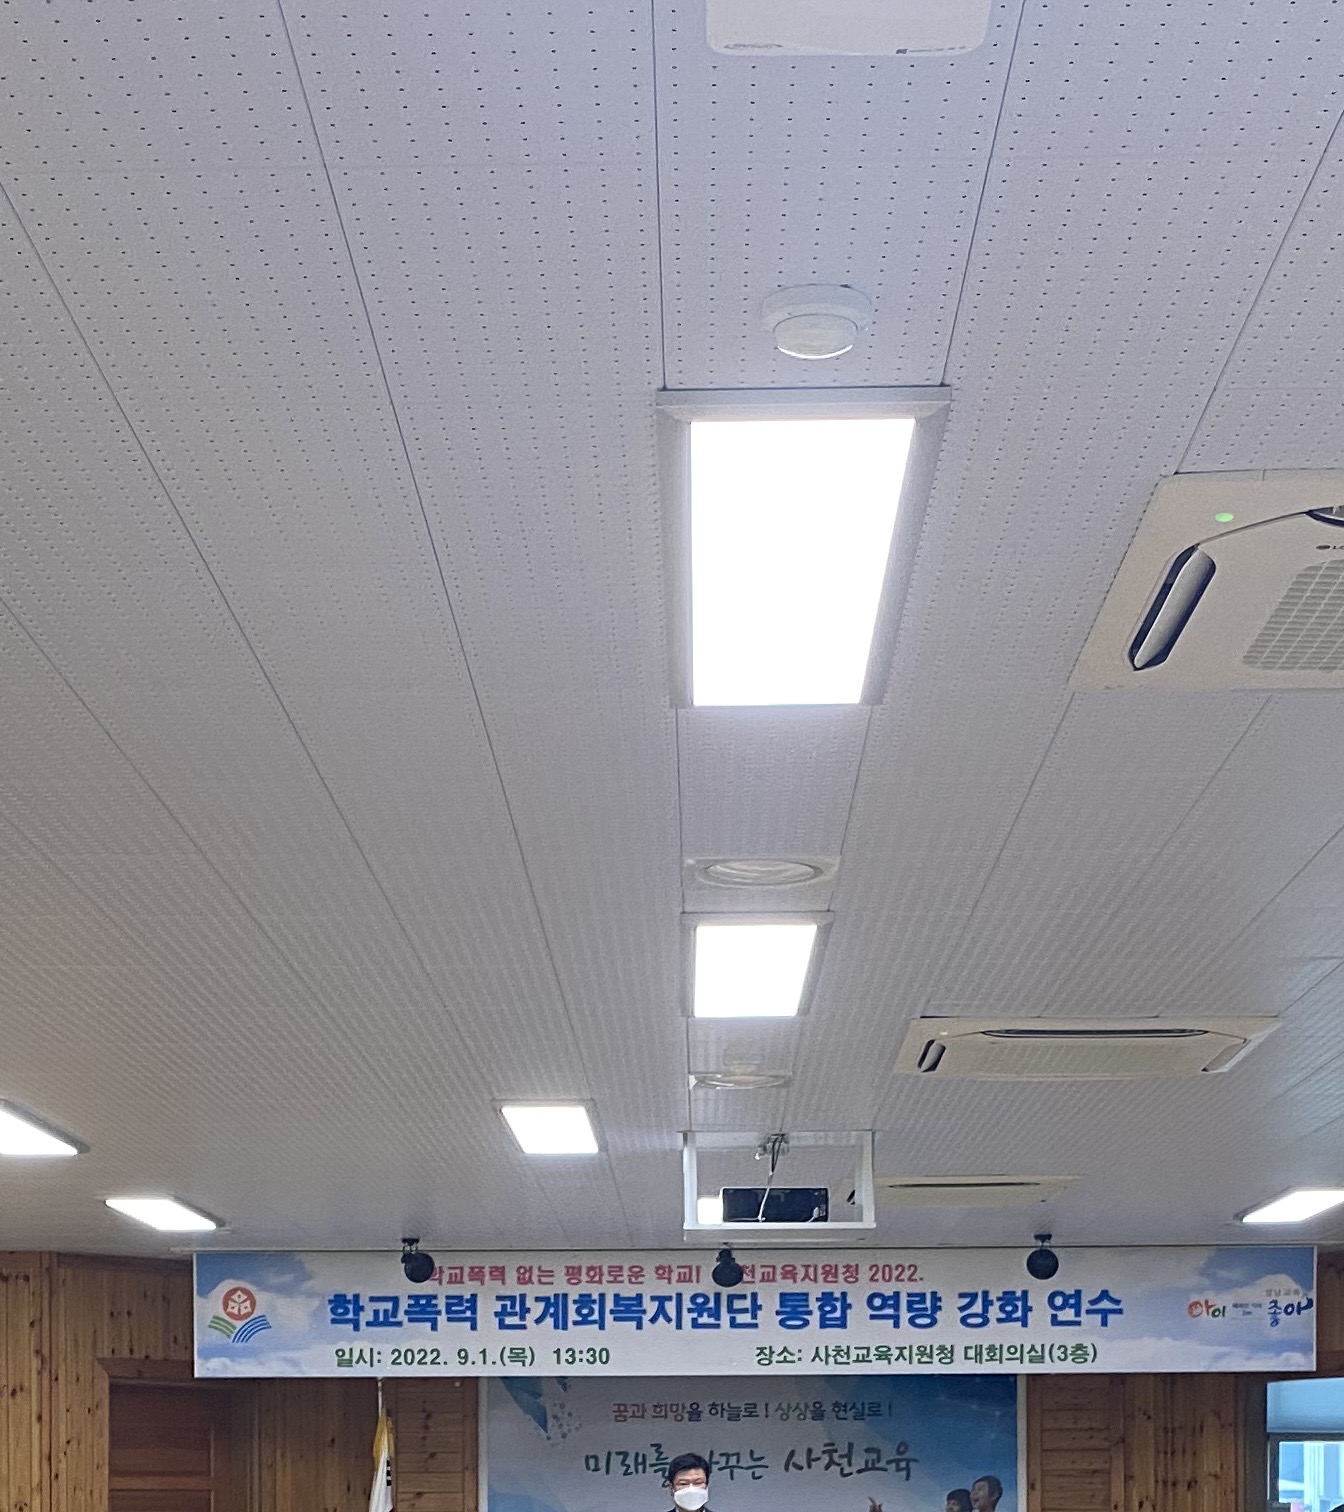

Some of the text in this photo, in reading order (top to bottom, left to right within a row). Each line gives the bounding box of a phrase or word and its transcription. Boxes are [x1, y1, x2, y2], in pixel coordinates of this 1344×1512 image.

[516, 1265, 554, 1285] 없는
[564, 1264, 645, 1286] 평화로운
[739, 1263, 859, 1284] 천교육지원청
[868, 1263, 924, 1282] 2022.
[328, 1289, 1123, 1332] 학교폭력 관계회복지원단 통합 역량 강화 연수
[335, 1346, 610, 1368] 일시: 2022. 9.1.(목) 13:30
[756, 1343, 1098, 1366] 장소: 사천교육지원청 대회의실(3층)
[613, 1402, 647, 1423] 꿈과
[651, 1402, 704, 1422] 희망을
[775, 1401, 826, 1421] 상상을
[584, 1443, 670, 1488] 미래를
[784, 1440, 919, 1482] 사천교육
